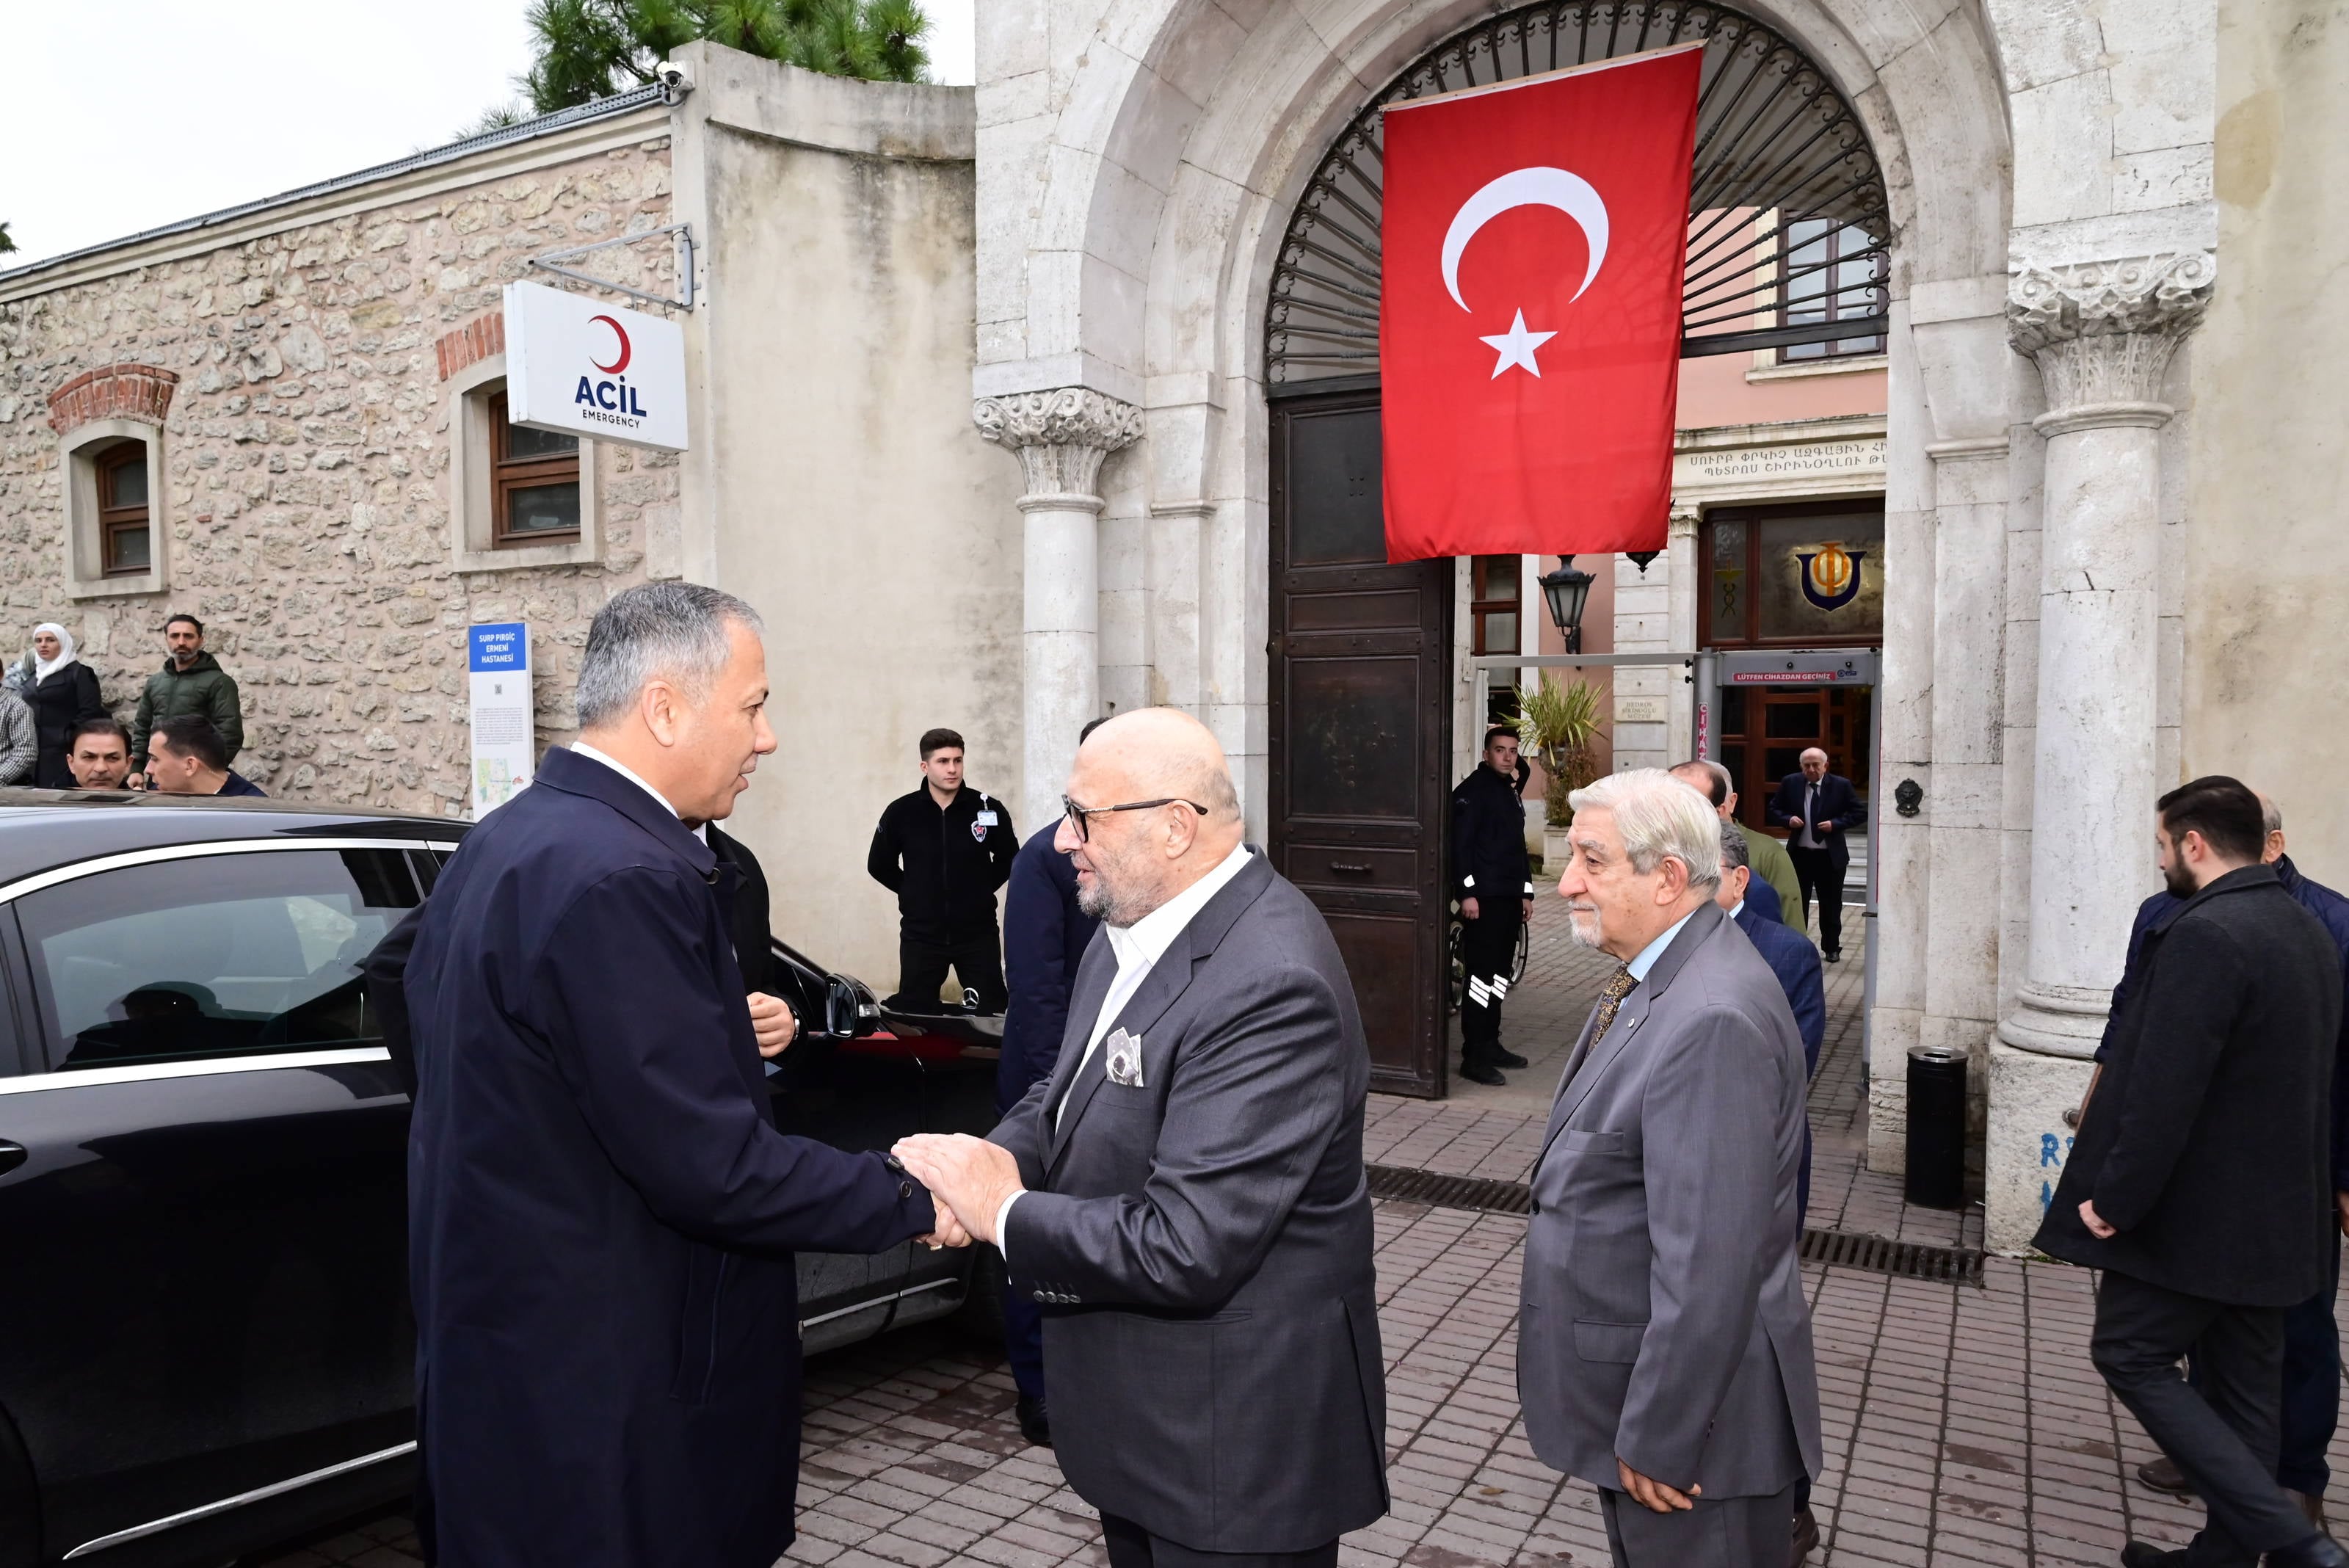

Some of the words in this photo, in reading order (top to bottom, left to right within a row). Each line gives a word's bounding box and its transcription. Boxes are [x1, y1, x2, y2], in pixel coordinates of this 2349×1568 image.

[575, 375, 647, 417] ACİL
[583, 409, 640, 429] EMERGENCY
[1691, 454, 1733, 465] ՍՈՒՐԲ
[1740, 449, 1786, 462] ՓՐԿԻՉ
[1794, 443, 1864, 457] ԱԶԳԱՅԻՆ
[1704, 464, 1758, 476] ՊԵՏՐՈՍ
[479, 634, 495, 643] SURP
[486, 642, 509, 653] ERMENİ
[482, 653, 514, 664] HASTANESİ
